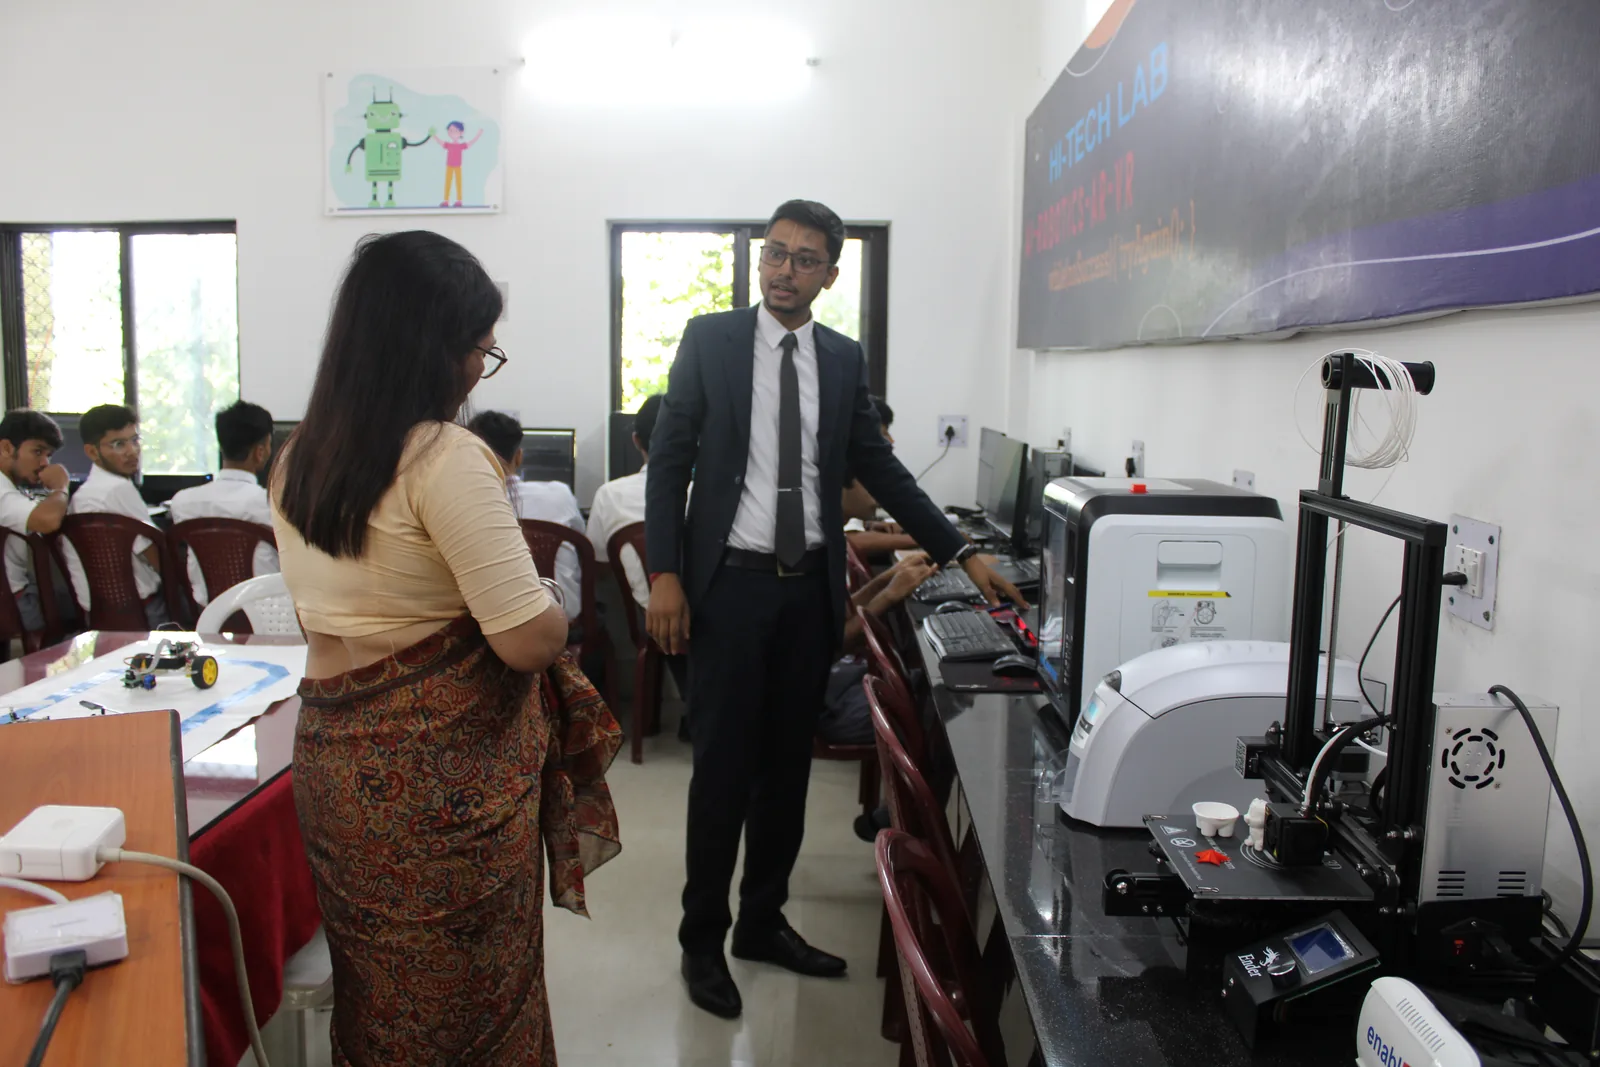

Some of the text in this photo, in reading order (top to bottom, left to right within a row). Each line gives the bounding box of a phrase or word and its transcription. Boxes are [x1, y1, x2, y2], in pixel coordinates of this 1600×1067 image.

[1049, 41, 1169, 185] HI-TECH LAB
[1238, 953, 1262, 978] Ender
